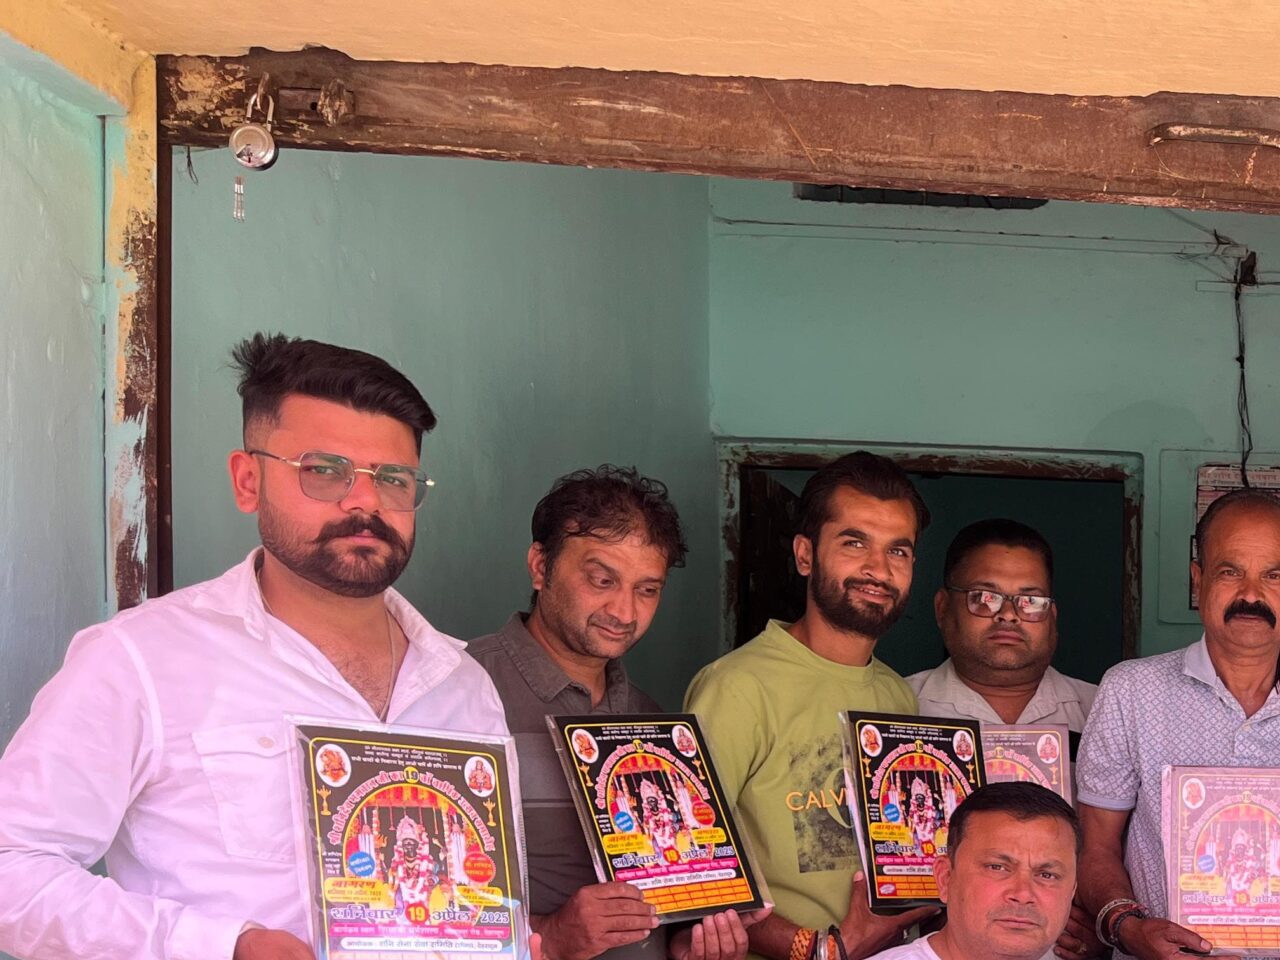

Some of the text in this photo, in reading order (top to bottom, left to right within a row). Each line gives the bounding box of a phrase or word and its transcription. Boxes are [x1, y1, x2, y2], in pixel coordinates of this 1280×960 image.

[923, 842, 934, 854] 19
[666, 850, 678, 862] 19
[408, 907, 427, 921] 19
[481, 911, 510, 924] 2025
